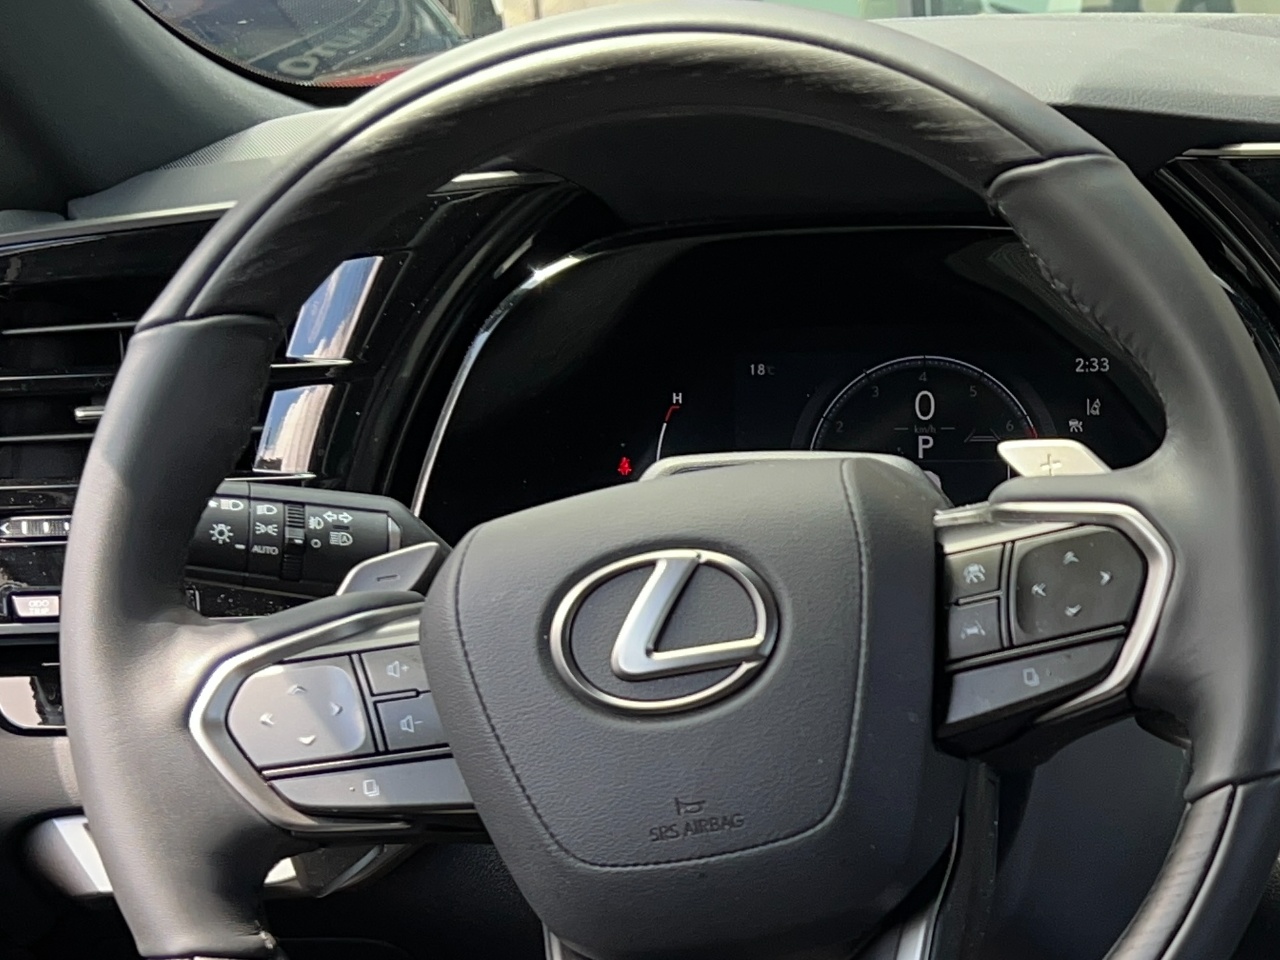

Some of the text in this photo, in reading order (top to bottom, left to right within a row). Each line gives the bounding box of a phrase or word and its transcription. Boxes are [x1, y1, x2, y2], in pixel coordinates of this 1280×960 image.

[1075, 358, 1109, 373] 2:33
[673, 393, 682, 404] H
[915, 390, 935, 420] 0
[918, 436, 934, 459] P
[252, 545, 279, 556] AUTO
[649, 813, 745, 842] SRS AIRBAG
